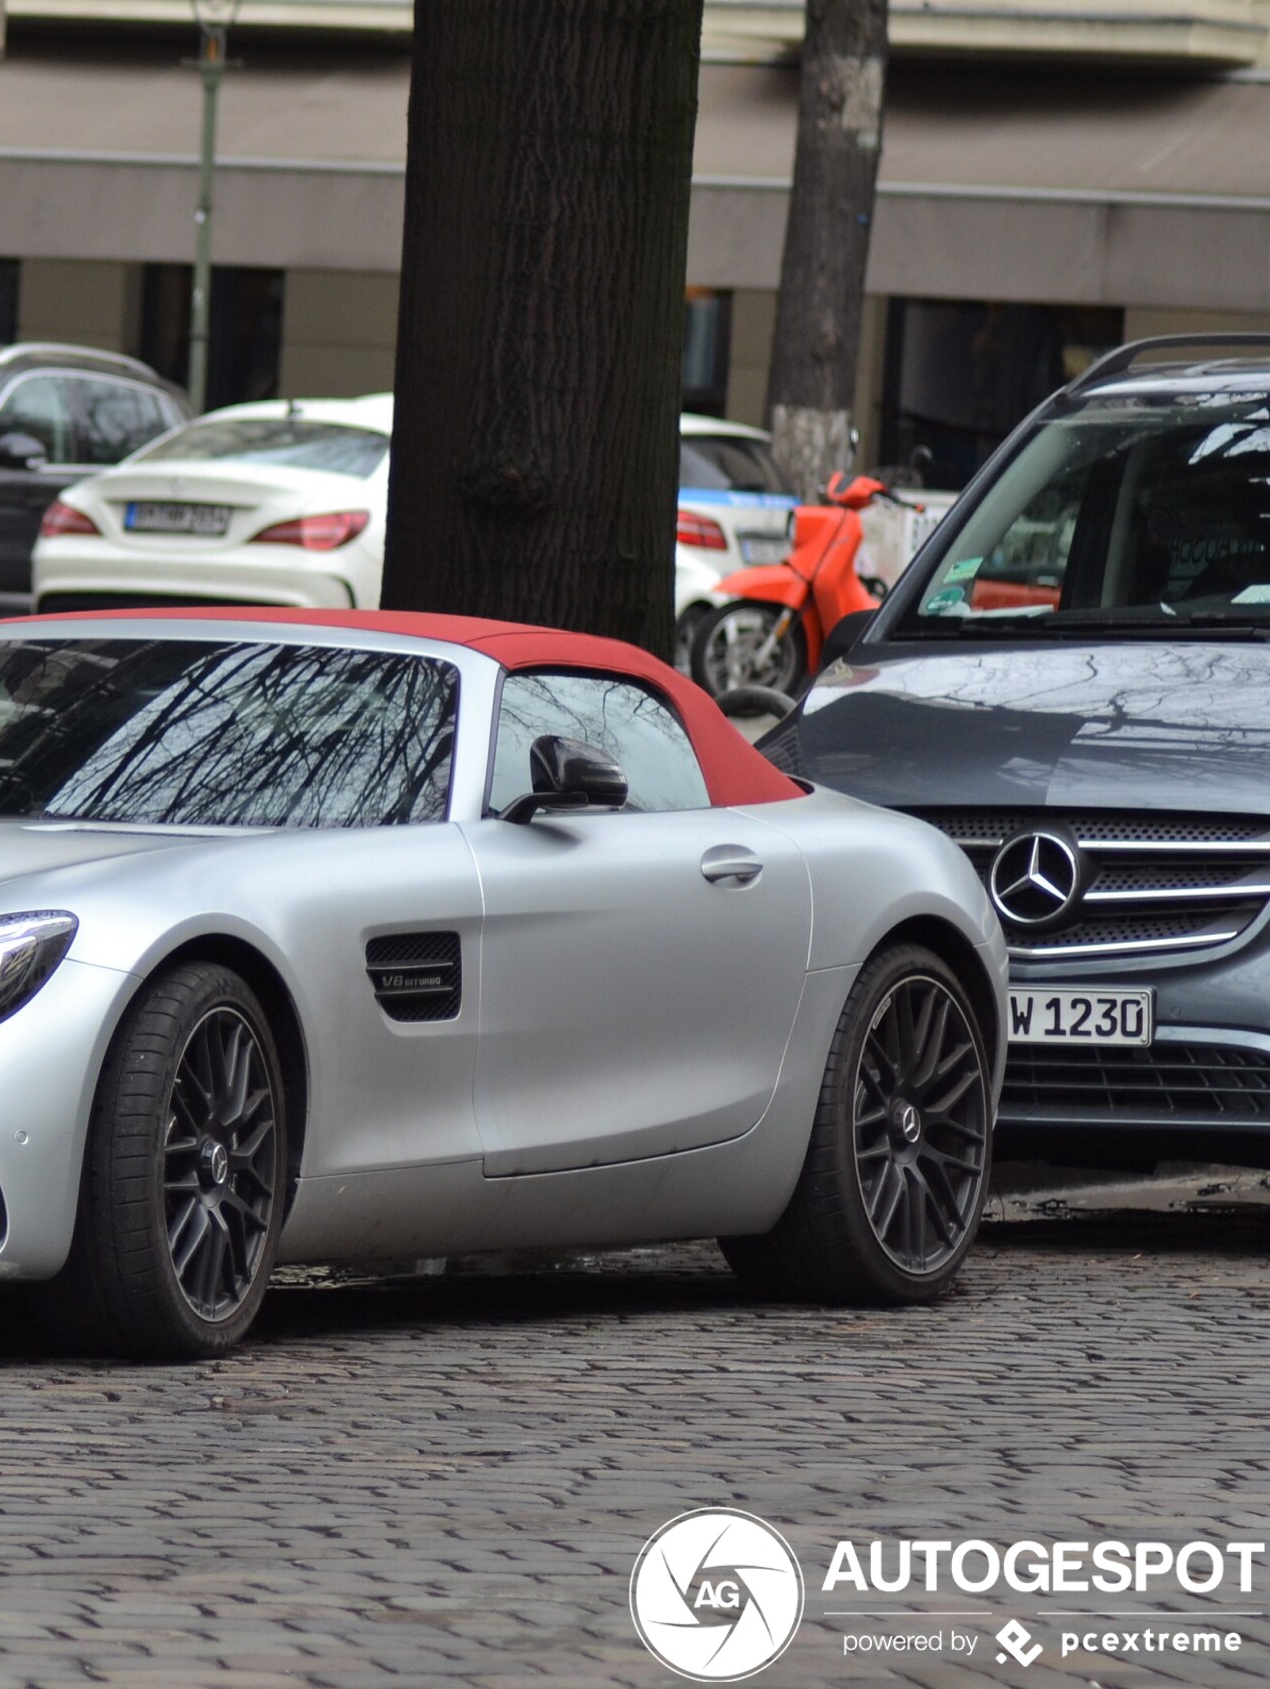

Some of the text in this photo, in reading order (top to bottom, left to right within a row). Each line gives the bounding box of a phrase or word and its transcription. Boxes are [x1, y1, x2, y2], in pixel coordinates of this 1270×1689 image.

[382, 975, 403, 987] V8
[1010, 996, 1143, 1037] W 1230
